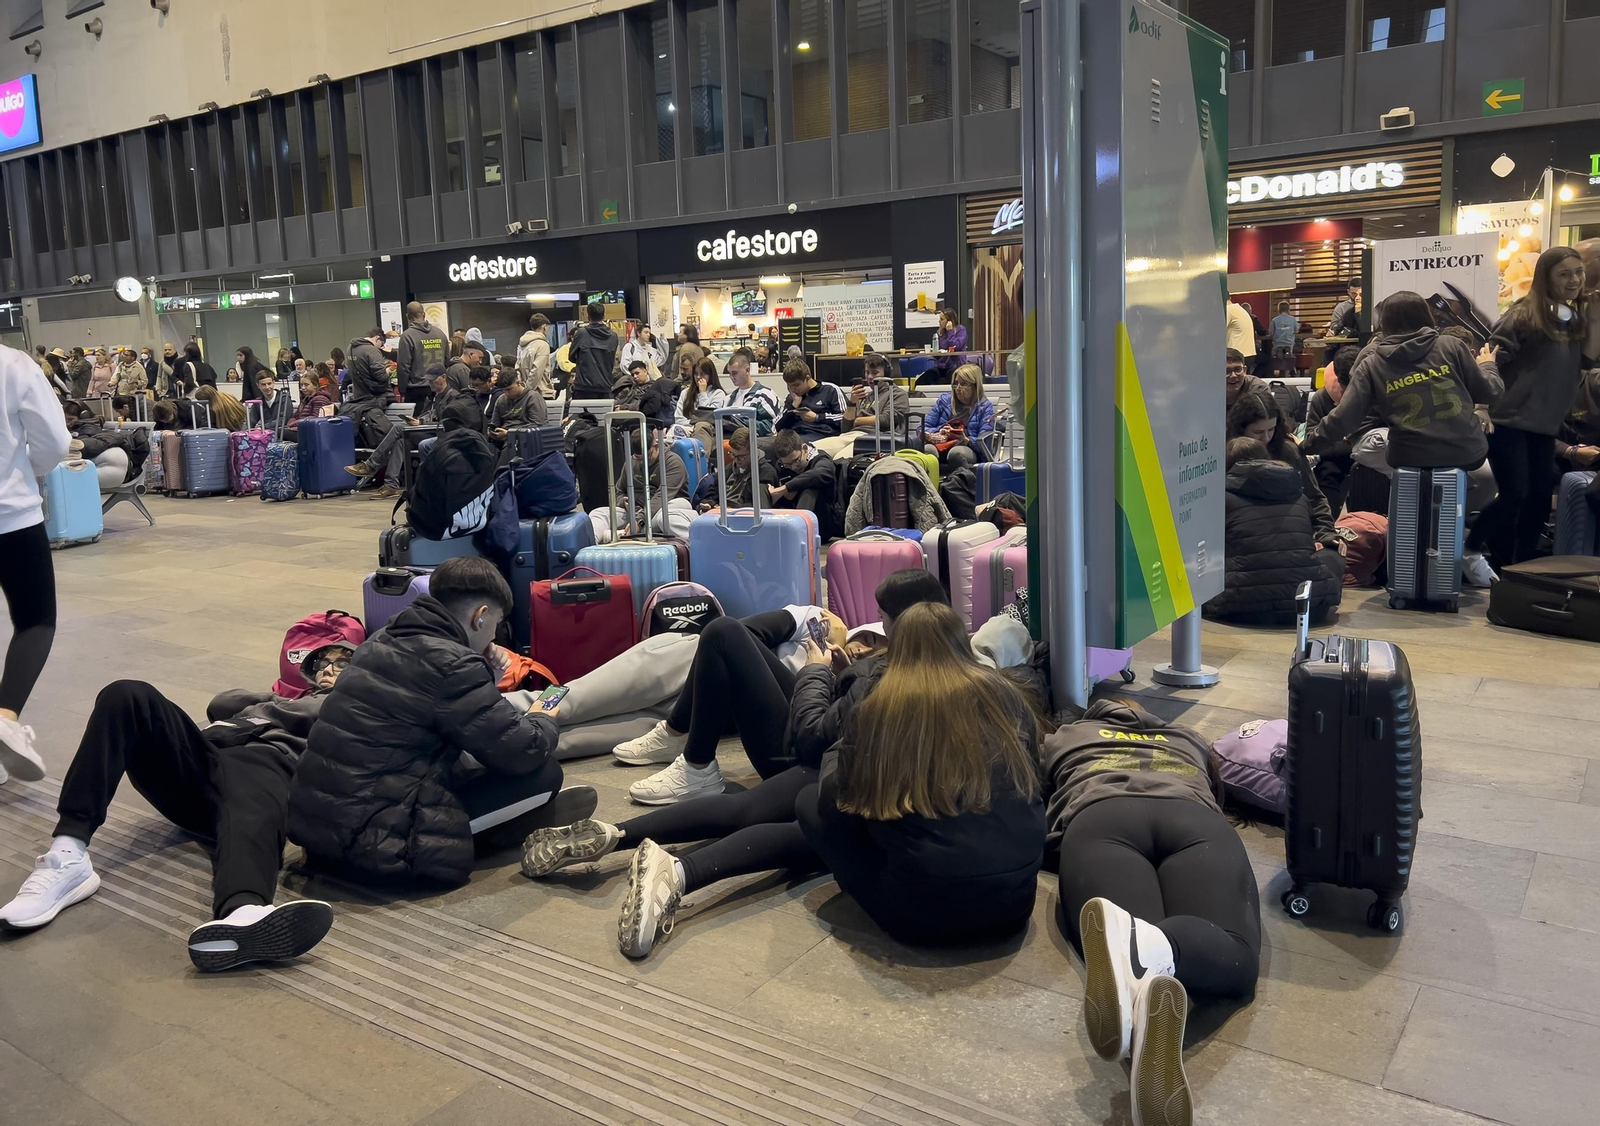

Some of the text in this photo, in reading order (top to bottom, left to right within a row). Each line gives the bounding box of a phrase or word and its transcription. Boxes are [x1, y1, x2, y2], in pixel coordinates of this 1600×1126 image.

[1140, 20, 1162, 41] adif
[1227, 162, 1404, 205] cDonald's
[697, 228, 818, 262] cafestore
[448, 254, 537, 282] cafestore
[1389, 253, 1484, 272] ENTRECOT
[1386, 364, 1450, 394] ÁNGELA.R
[1390, 379, 1463, 428] 25
[1178, 435, 1208, 459] Punto de
[1178, 455, 1218, 485] información
[451, 483, 495, 534] NIKE
[1178, 486, 1207, 507] INFORMATION
[1179, 508, 1192, 525] POINT
[662, 602, 709, 617] Reebok
[1098, 729, 1170, 743] CARLA
